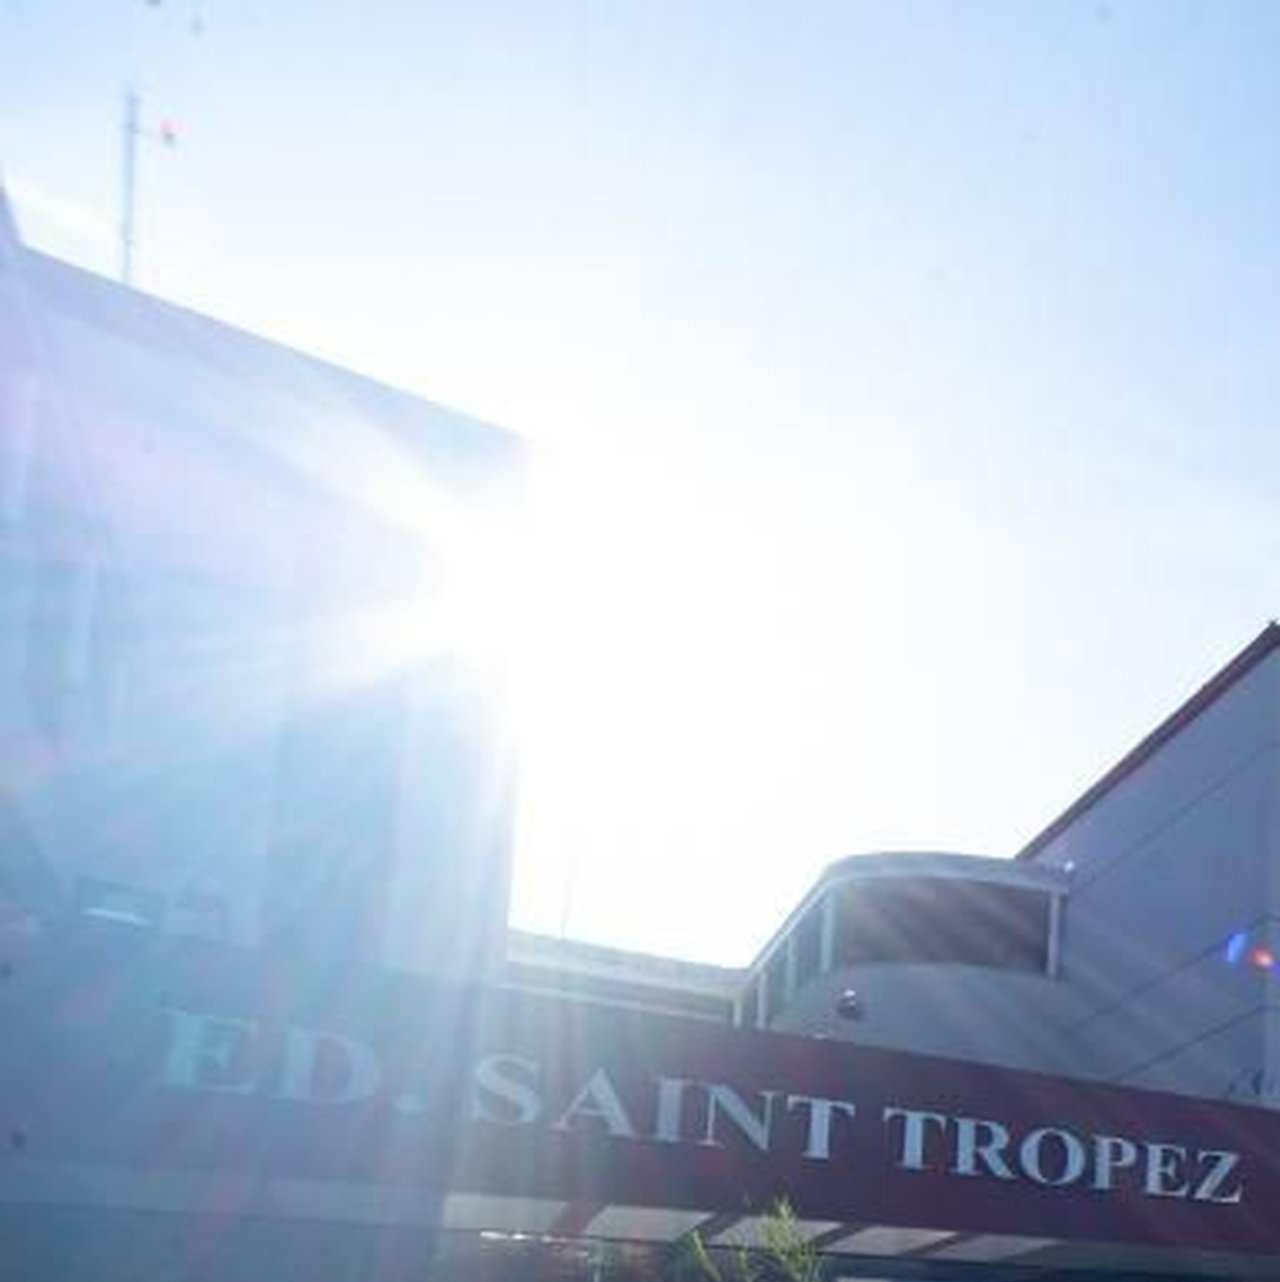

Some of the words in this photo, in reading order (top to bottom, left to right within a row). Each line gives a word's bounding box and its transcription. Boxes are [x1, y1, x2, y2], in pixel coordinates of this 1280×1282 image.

[161, 1008, 422, 1114] ED.
[470, 1052, 856, 1162] SAINT
[884, 1107, 1245, 1204] TROPEZ
